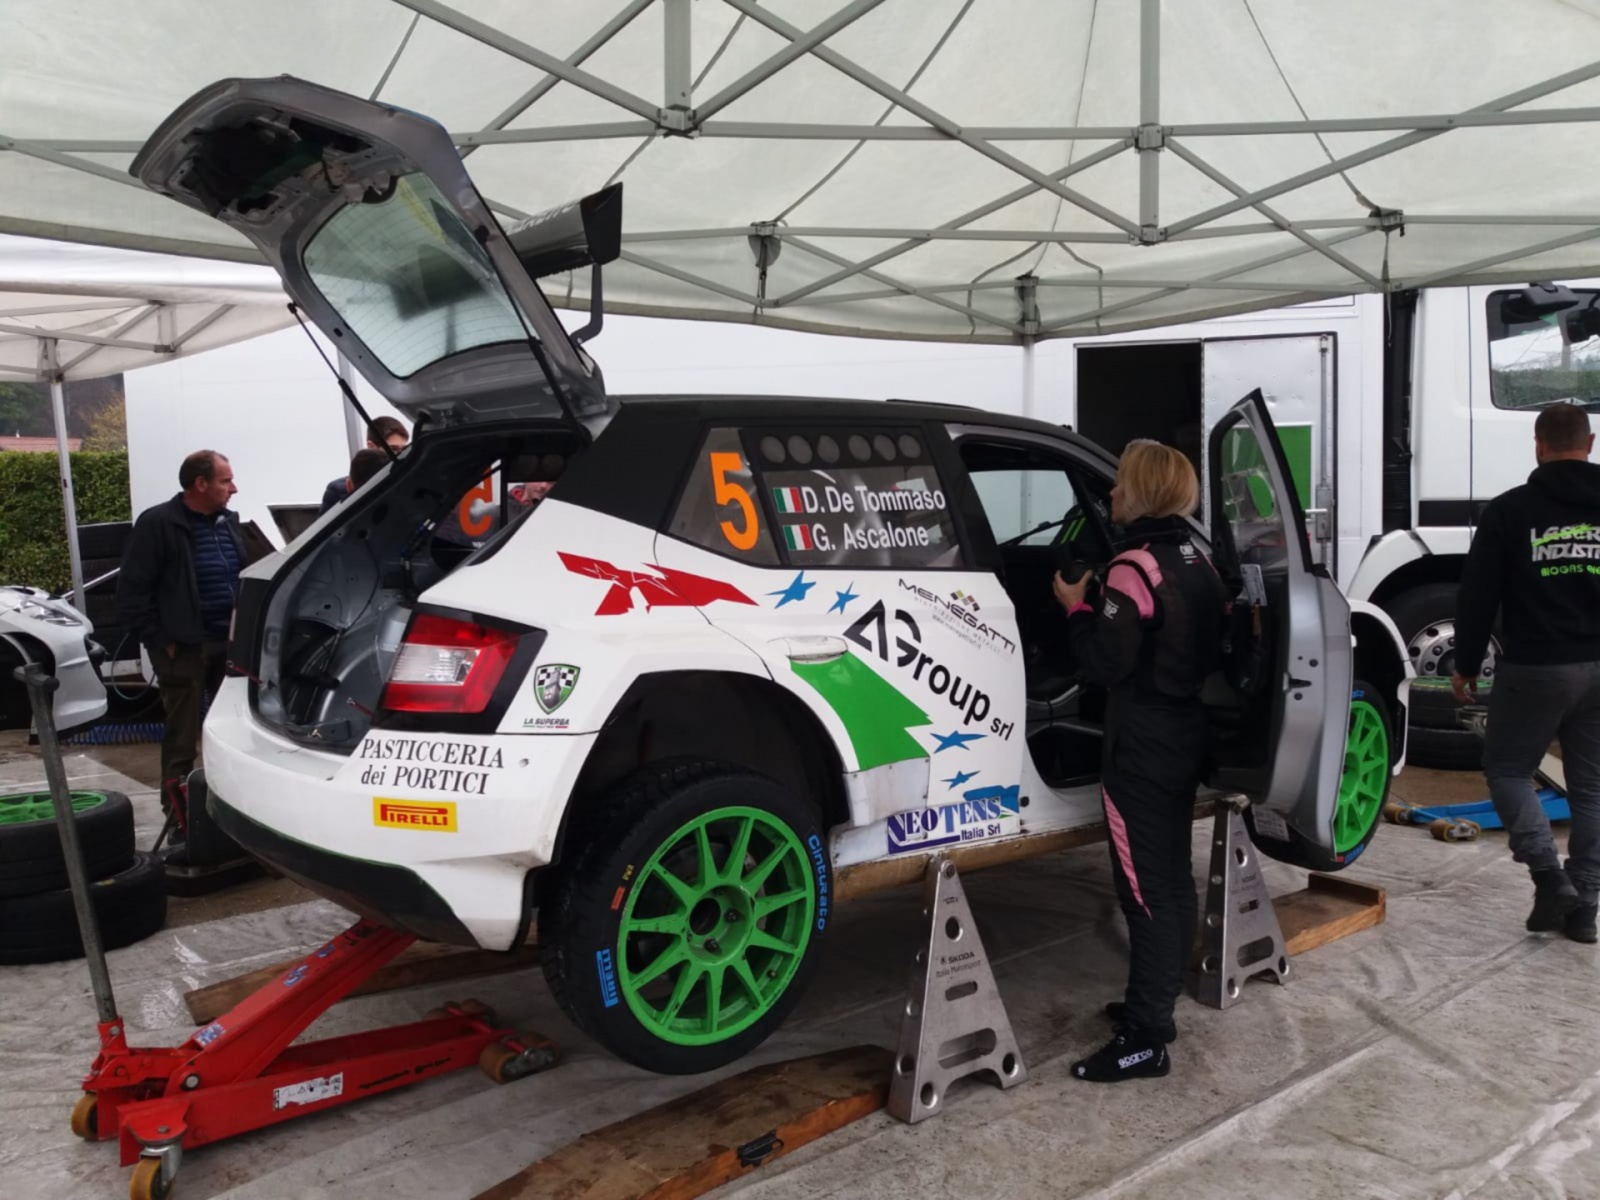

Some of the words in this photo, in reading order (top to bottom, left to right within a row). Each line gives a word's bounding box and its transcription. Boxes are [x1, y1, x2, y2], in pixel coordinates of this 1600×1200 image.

[709, 452, 760, 551] 5
[801, 485, 826, 514] D.
[825, 485, 855, 514] De
[855, 485, 946, 512] Tommaso
[812, 523, 836, 551] G.
[843, 521, 930, 550] Ascalone
[898, 578, 1016, 655] MENEGATTI
[535, 717, 570, 726] SUPERBA
[990, 717, 1015, 741] srl
[360, 738, 504, 769] PASTICCERIA
[361, 764, 387, 786] dei
[392, 766, 490, 795] PORTICI
[380, 803, 448, 827] PIRELLI
[961, 827, 985, 841] Italia
[988, 824, 1001, 836] Srl
[808, 833, 826, 931] Cinturato
[596, 948, 619, 1008] PIRELLI
